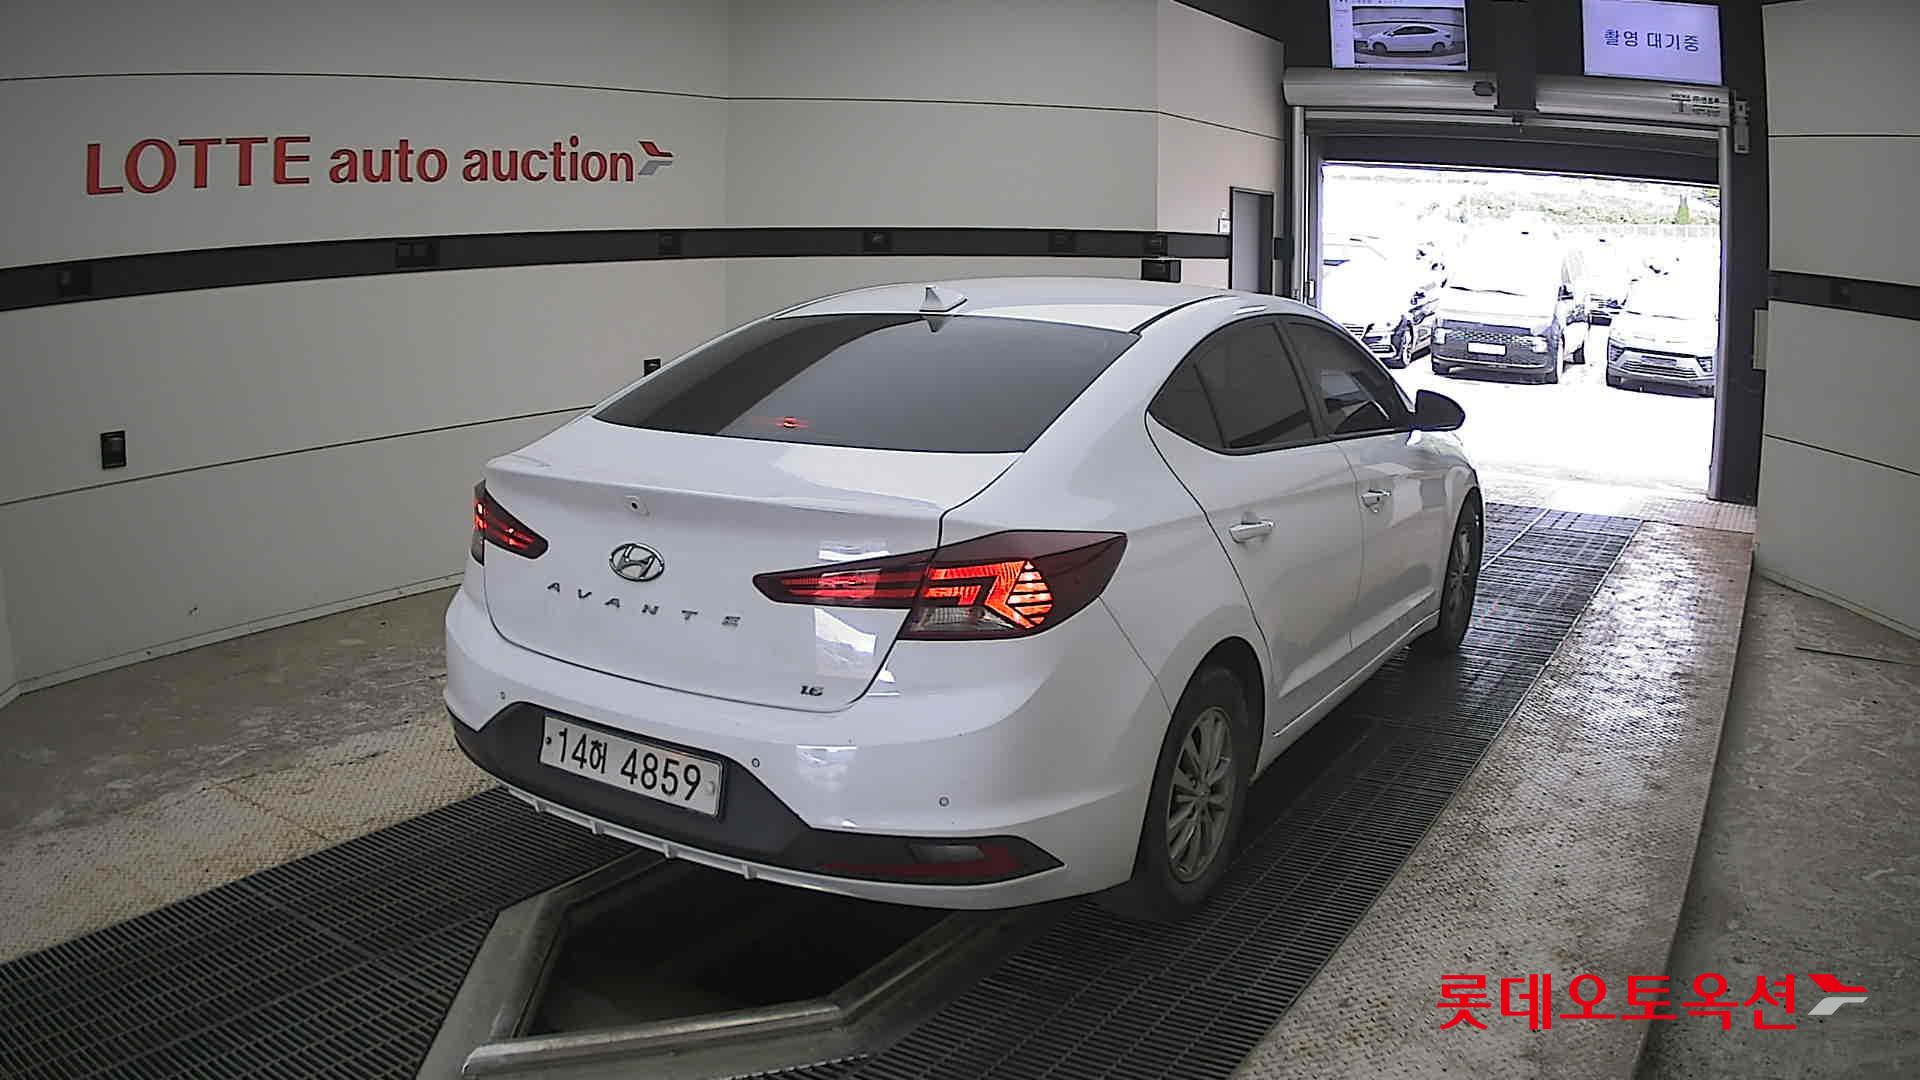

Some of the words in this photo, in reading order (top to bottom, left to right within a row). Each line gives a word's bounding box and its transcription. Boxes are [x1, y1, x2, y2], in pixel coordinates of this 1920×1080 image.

[1604, 29, 1638, 47] 촬영
[1647, 32, 1699, 52] 대기중
[86, 136, 311, 195] LOTTE
[328, 139, 448, 184] auto
[462, 136, 634, 183] auction
[547, 582, 741, 628] AVANTE
[558, 728, 608, 774] 14허
[620, 748, 702, 801] 4859
